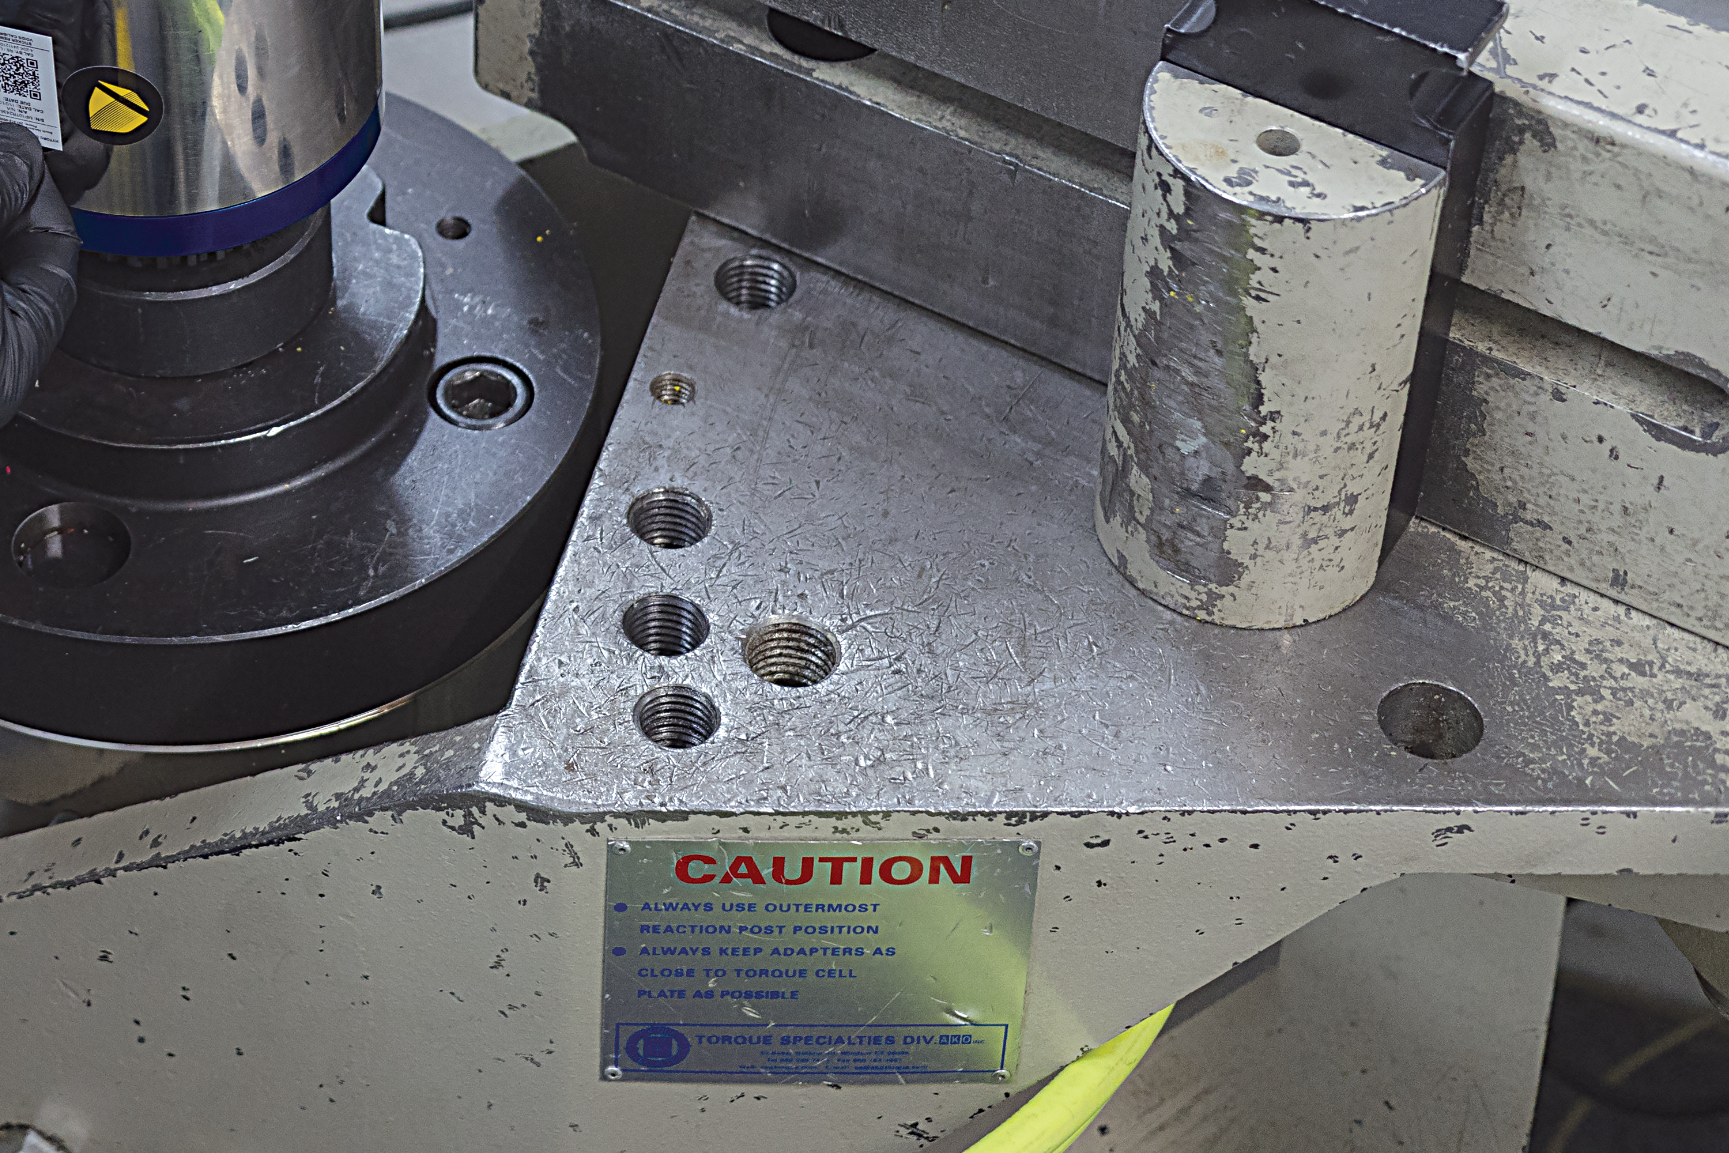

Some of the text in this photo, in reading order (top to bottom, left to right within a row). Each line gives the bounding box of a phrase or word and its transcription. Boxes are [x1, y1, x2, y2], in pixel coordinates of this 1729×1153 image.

[675, 854, 973, 886] CAUTION
[640, 902, 880, 913] ALWAYS USE OUTERMOST
[639, 924, 879, 934] REACTION POST POSITION
[639, 946, 896, 957] ALWAYS KEEP ADAPTERS AS
[638, 968, 857, 979] CLOSE TO TORQUE CELL
[637, 989, 799, 1000] PLATE AS POSSIBLE
[695, 1034, 772, 1045] TORQUE
[780, 1034, 895, 1045] SPECIALTIES
[903, 1034, 937, 1045] DIV.
[938, 1034, 971, 1044] AKO
